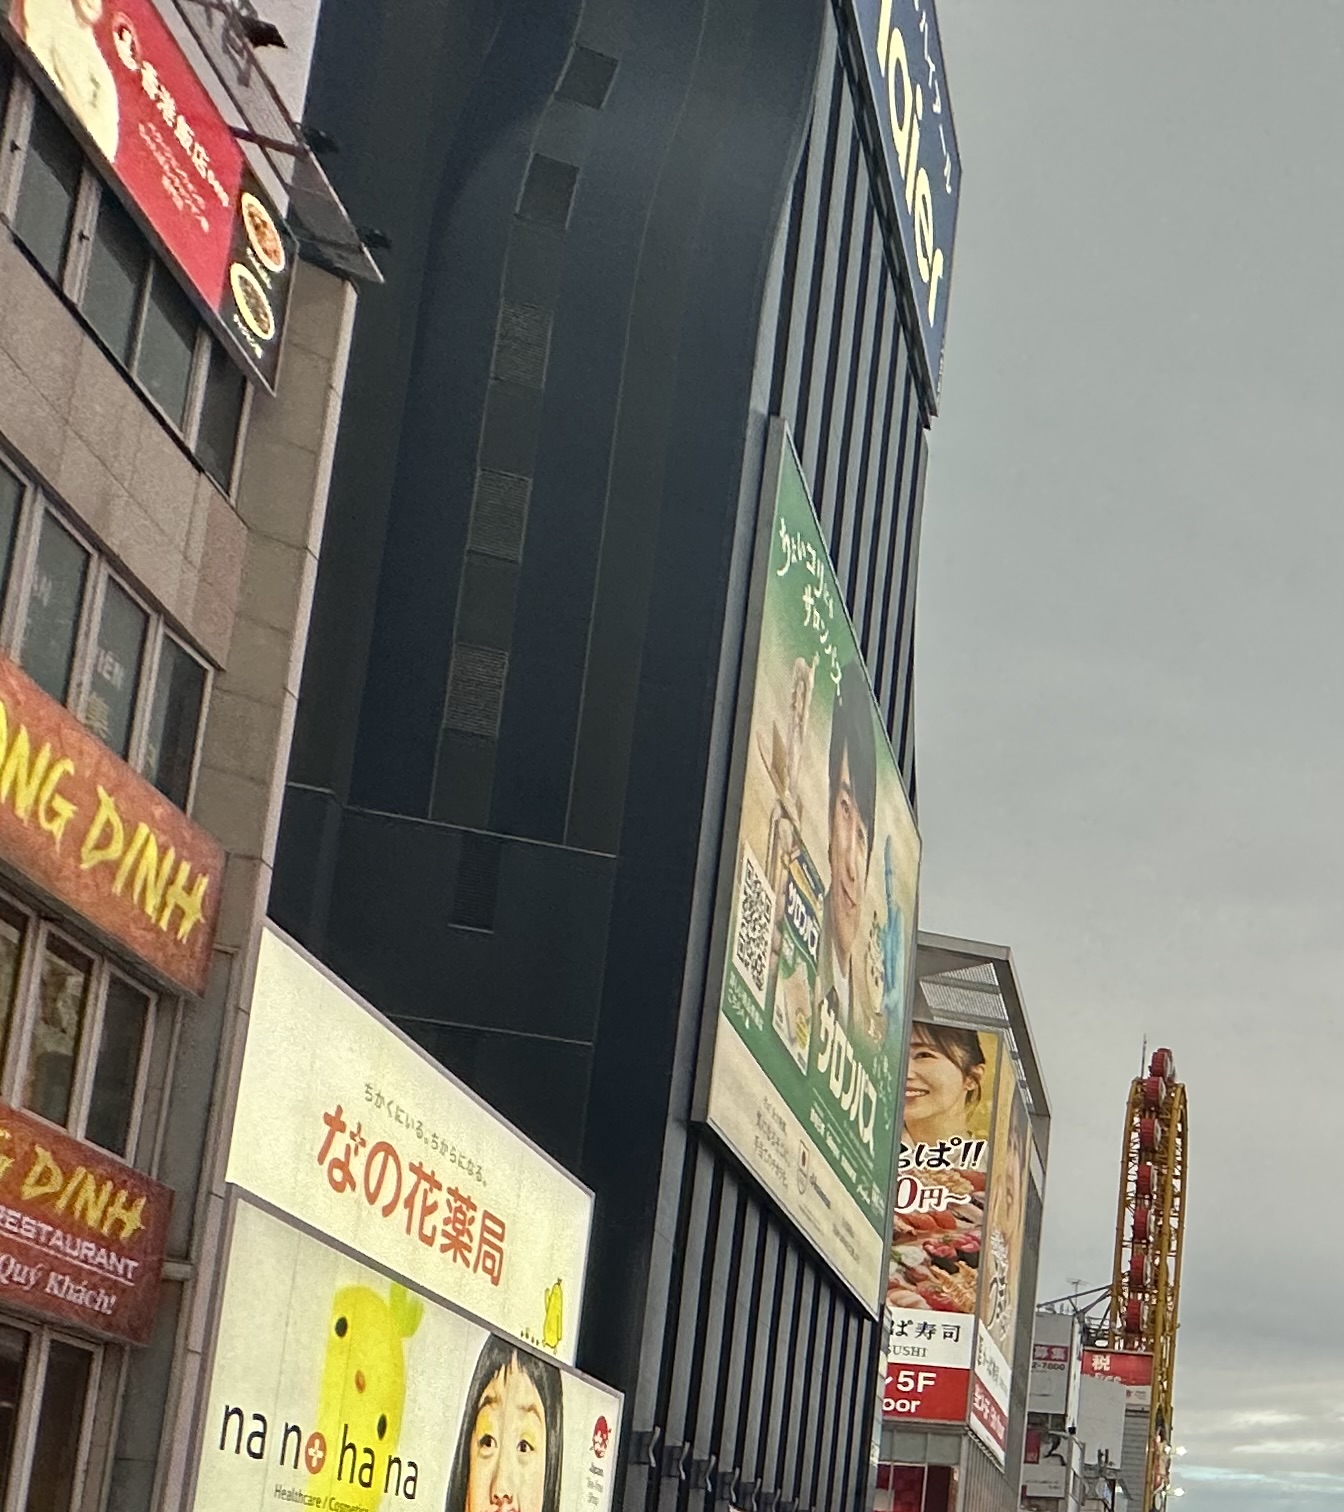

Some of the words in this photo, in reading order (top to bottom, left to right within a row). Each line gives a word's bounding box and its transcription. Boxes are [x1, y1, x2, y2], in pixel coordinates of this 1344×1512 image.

[80, 784, 208, 940] DINH
[364, 1083, 488, 1188] ちかくにいる。ちからになる。
[21, 1144, 147, 1242] DINH
[316, 1104, 506, 1287] なの花薬局
[897, 1371, 937, 1392] 5F
